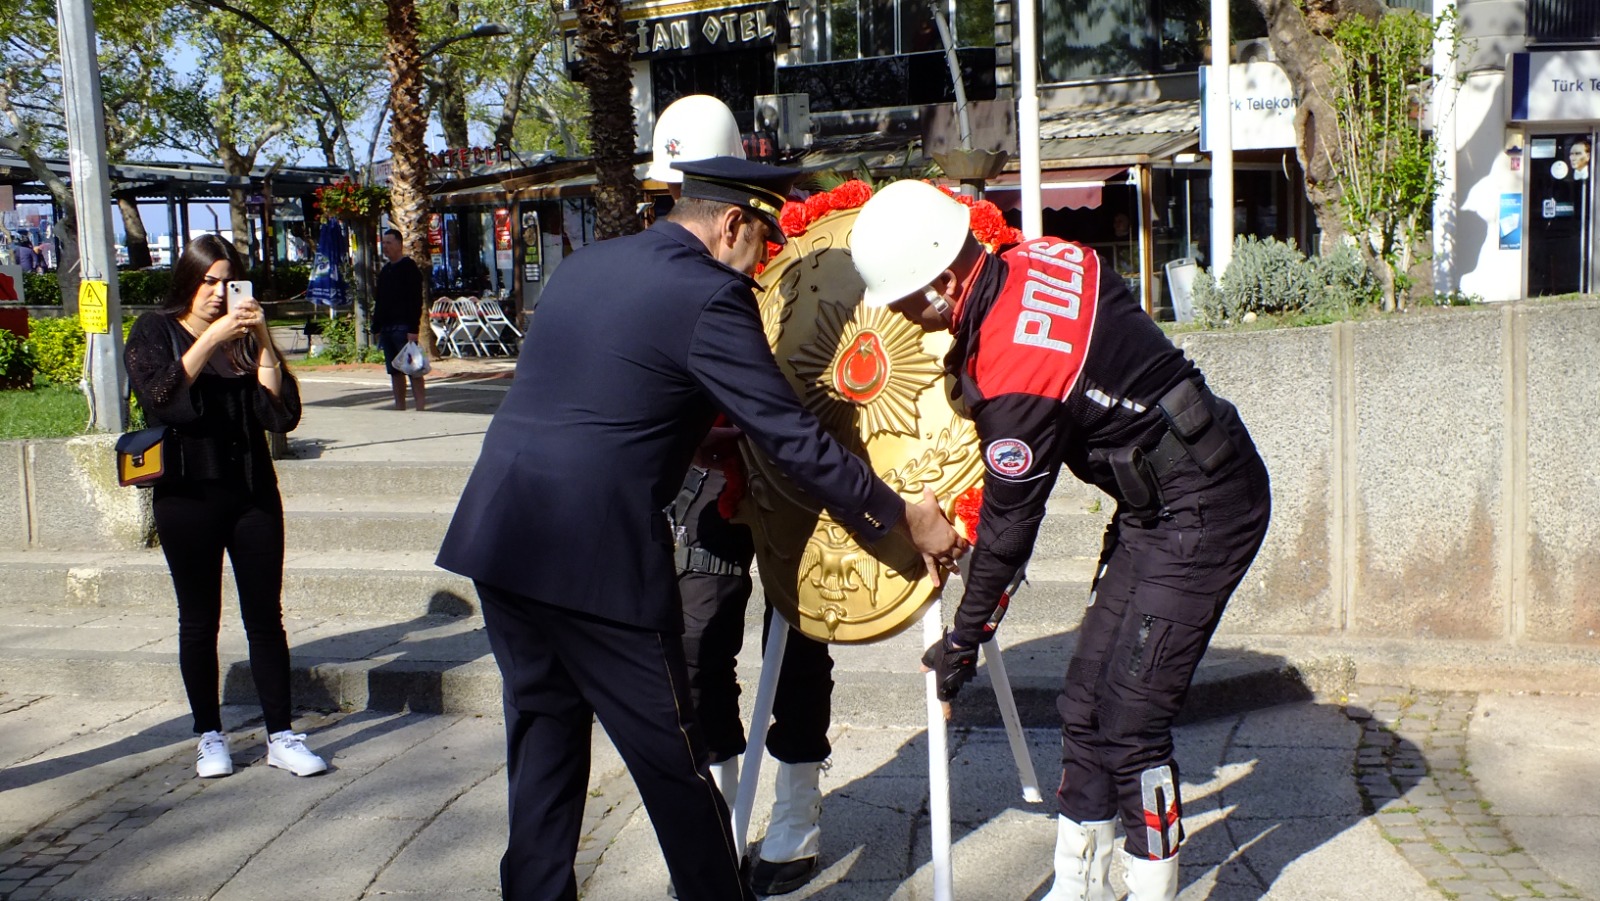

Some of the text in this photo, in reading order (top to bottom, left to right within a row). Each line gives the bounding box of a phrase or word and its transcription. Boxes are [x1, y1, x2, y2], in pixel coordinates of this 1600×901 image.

[636, 10, 774, 54] İAN OTEL
[1552, 79, 1584, 92] Türk
[1013, 242, 1084, 354] POLİS
